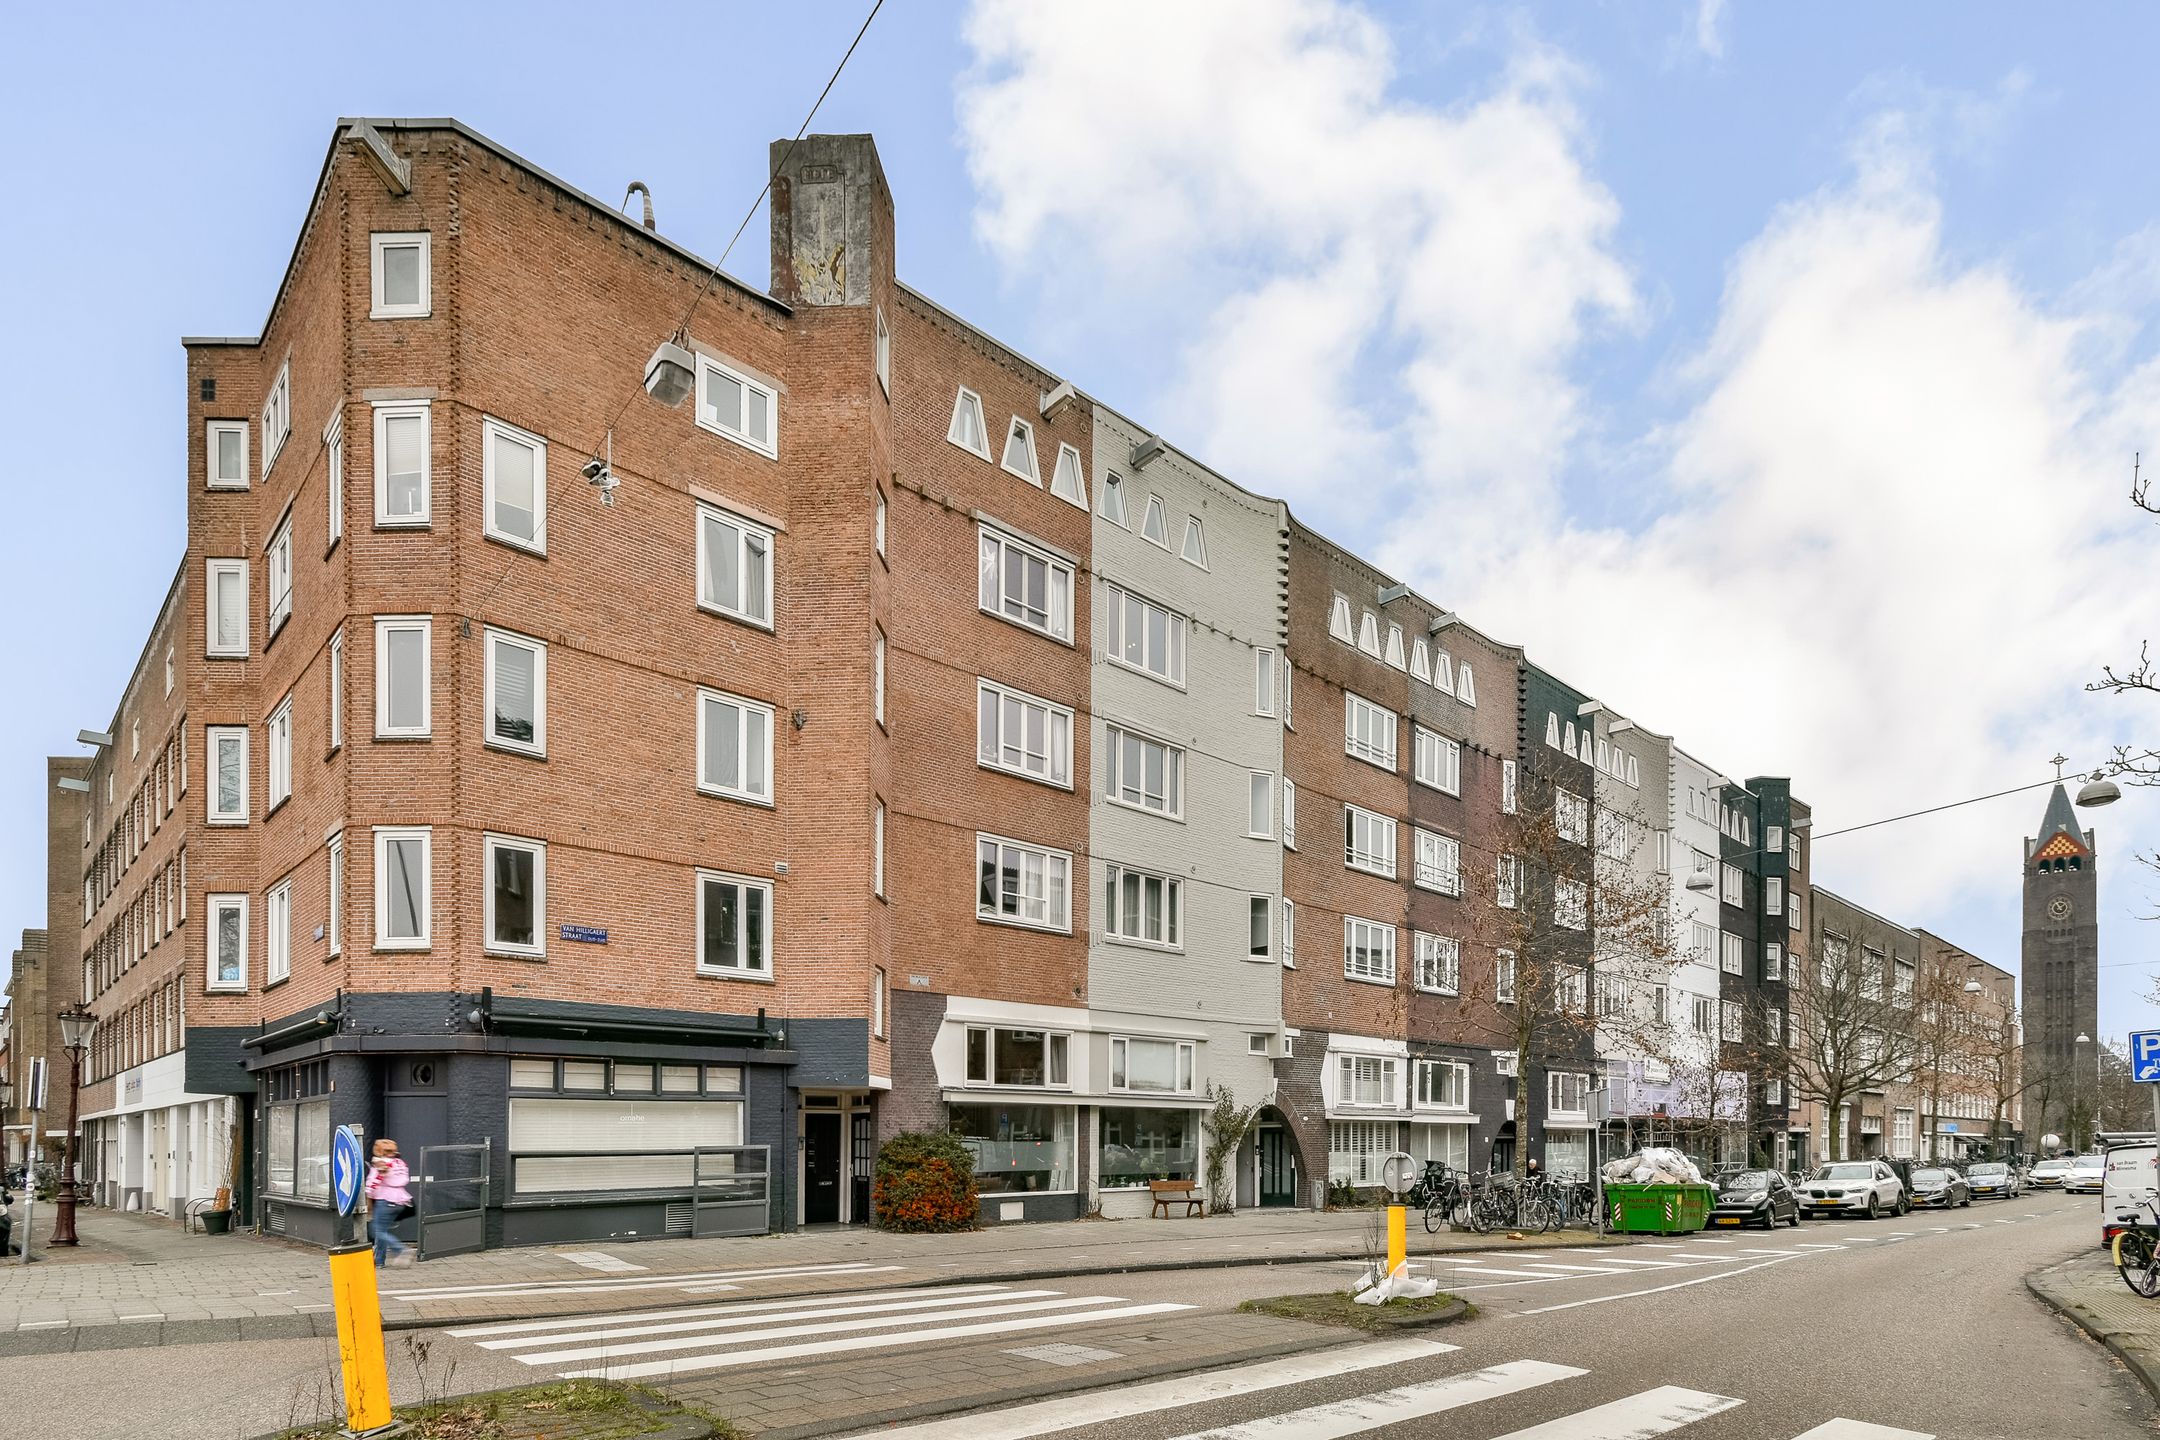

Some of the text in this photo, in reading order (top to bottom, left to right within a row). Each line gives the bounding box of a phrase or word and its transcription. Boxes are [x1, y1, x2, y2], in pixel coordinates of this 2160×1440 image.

[562, 932, 582, 940] STRAAT
[576, 927, 606, 936] HILLIGAERT
[2140, 1034, 2160, 1061] P
